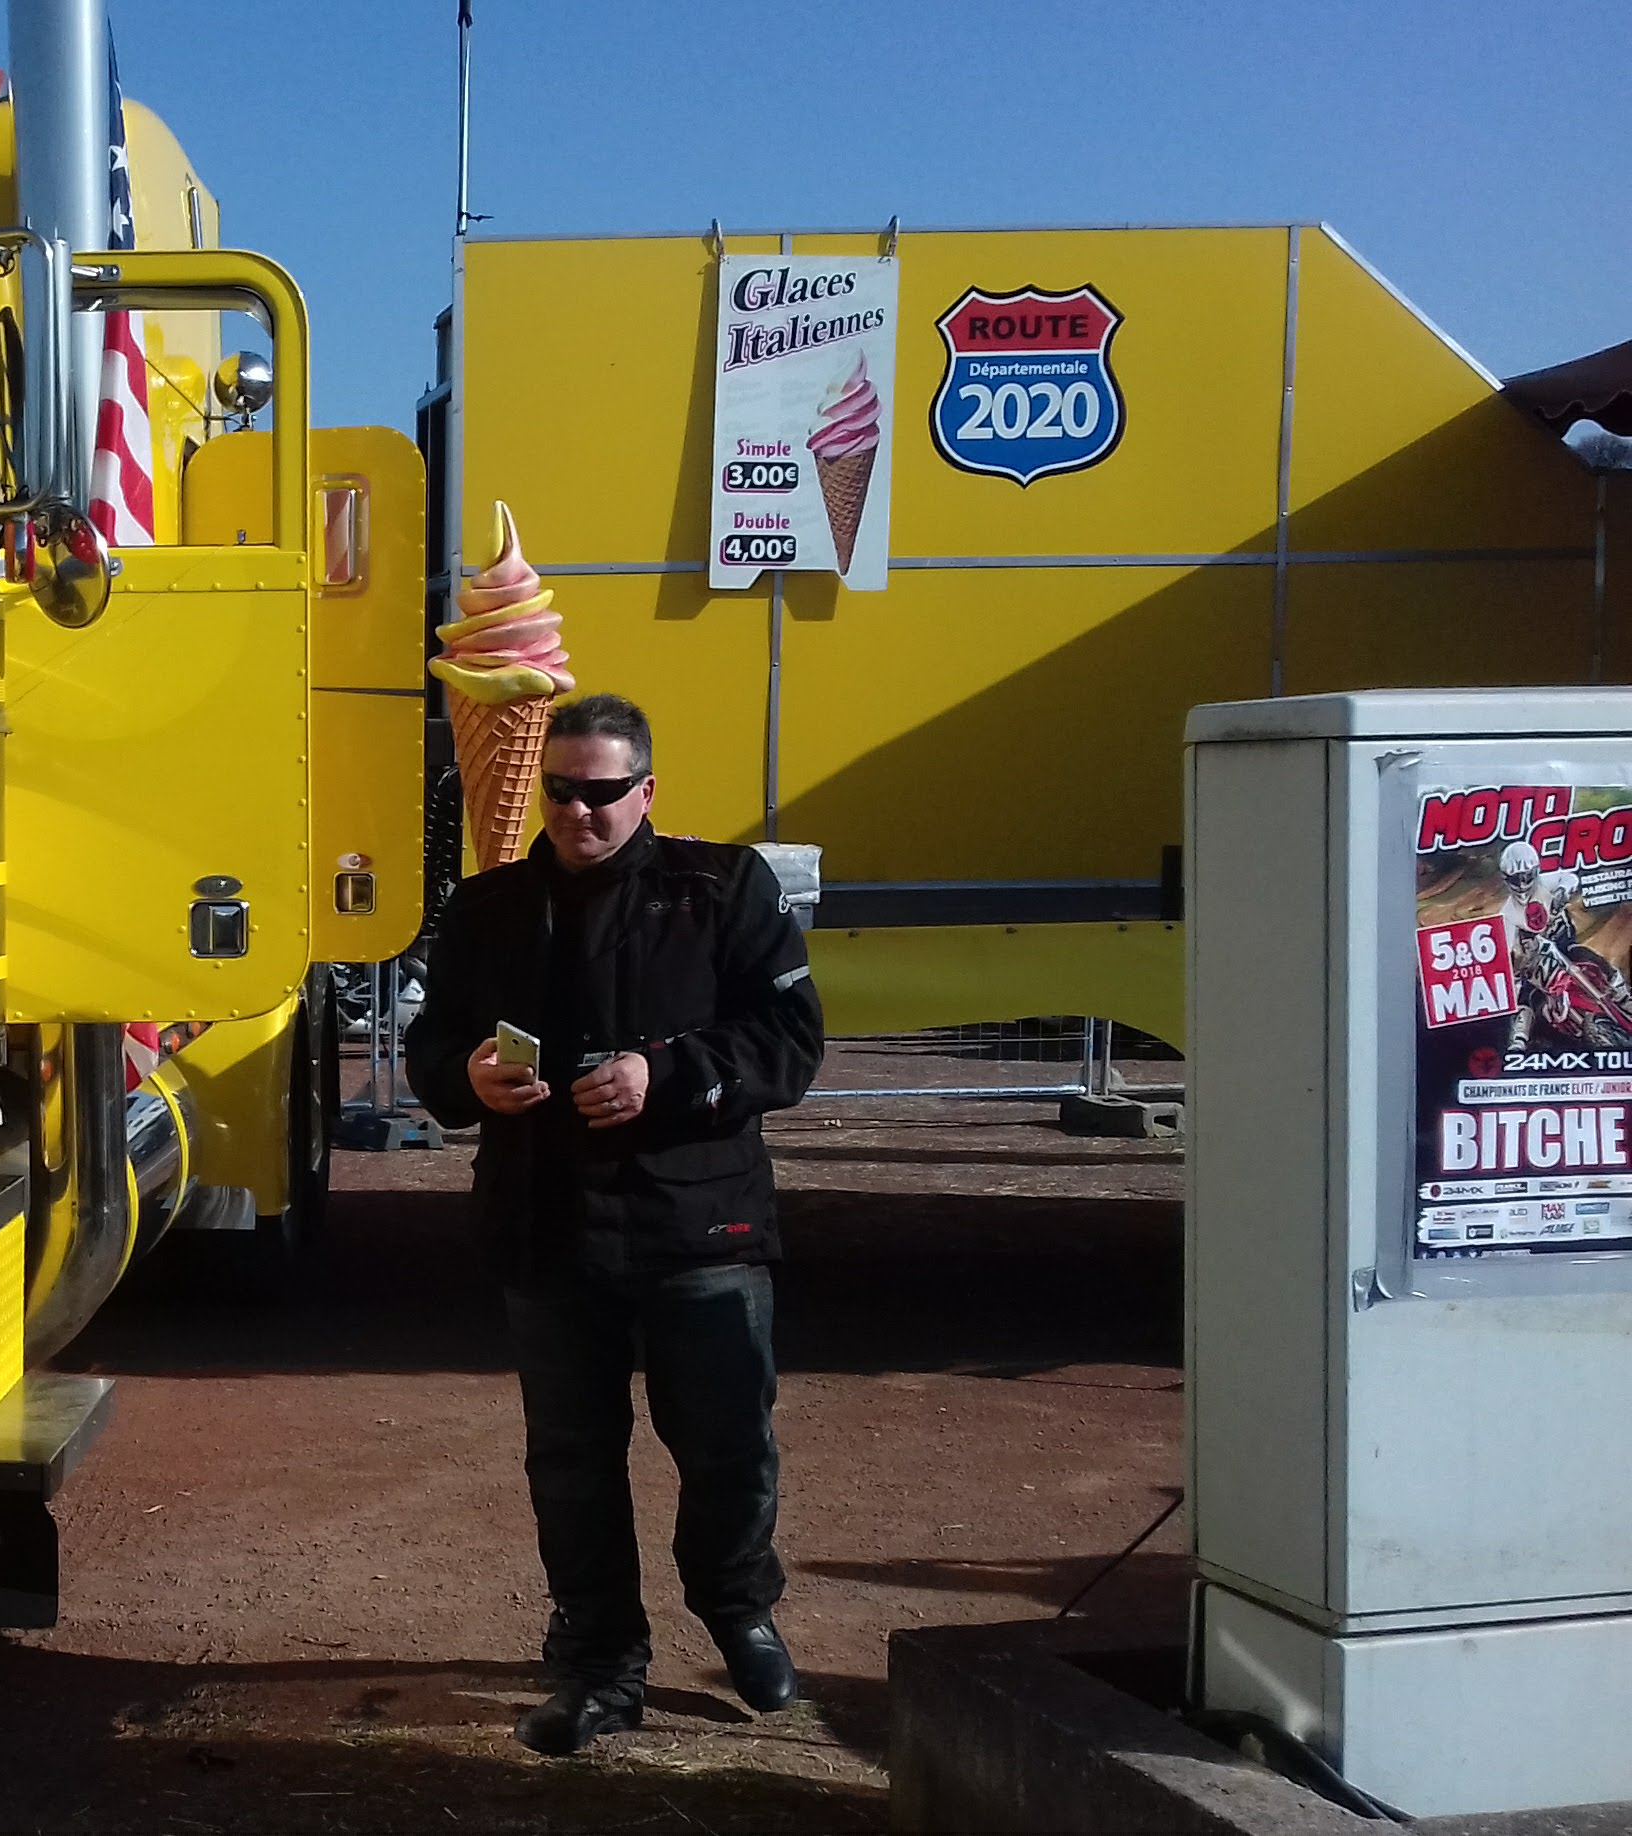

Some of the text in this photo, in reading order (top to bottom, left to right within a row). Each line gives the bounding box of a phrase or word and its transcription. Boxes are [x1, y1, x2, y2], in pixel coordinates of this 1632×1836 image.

[730, 265, 856, 314] Glaces
[725, 306, 885, 371] Italiennes
[969, 314, 1089, 340] ROUTE
[969, 360, 1089, 379] Départementale
[956, 381, 1100, 440] 2020
[736, 438, 792, 459] Simple
[728, 465, 797, 489] 3,00€
[733, 512, 790, 529] Double
[725, 538, 795, 562] 4,00€
[1418, 786, 1573, 851] MOTO
[1430, 924, 1496, 970] 5&6
[1452, 966, 1482, 980] 2018
[1431, 973, 1509, 1022] MAI
[1503, 1052, 1592, 1071] 24MX
[1463, 1084, 1527, 1098] CHAMPIONNATS
[1528, 1084, 1538, 1097] DE
[1539, 1083, 1571, 1096] FRANCE
[1572, 1082, 1593, 1095] ELITE
[1442, 1107, 1626, 1170] BITCHE
